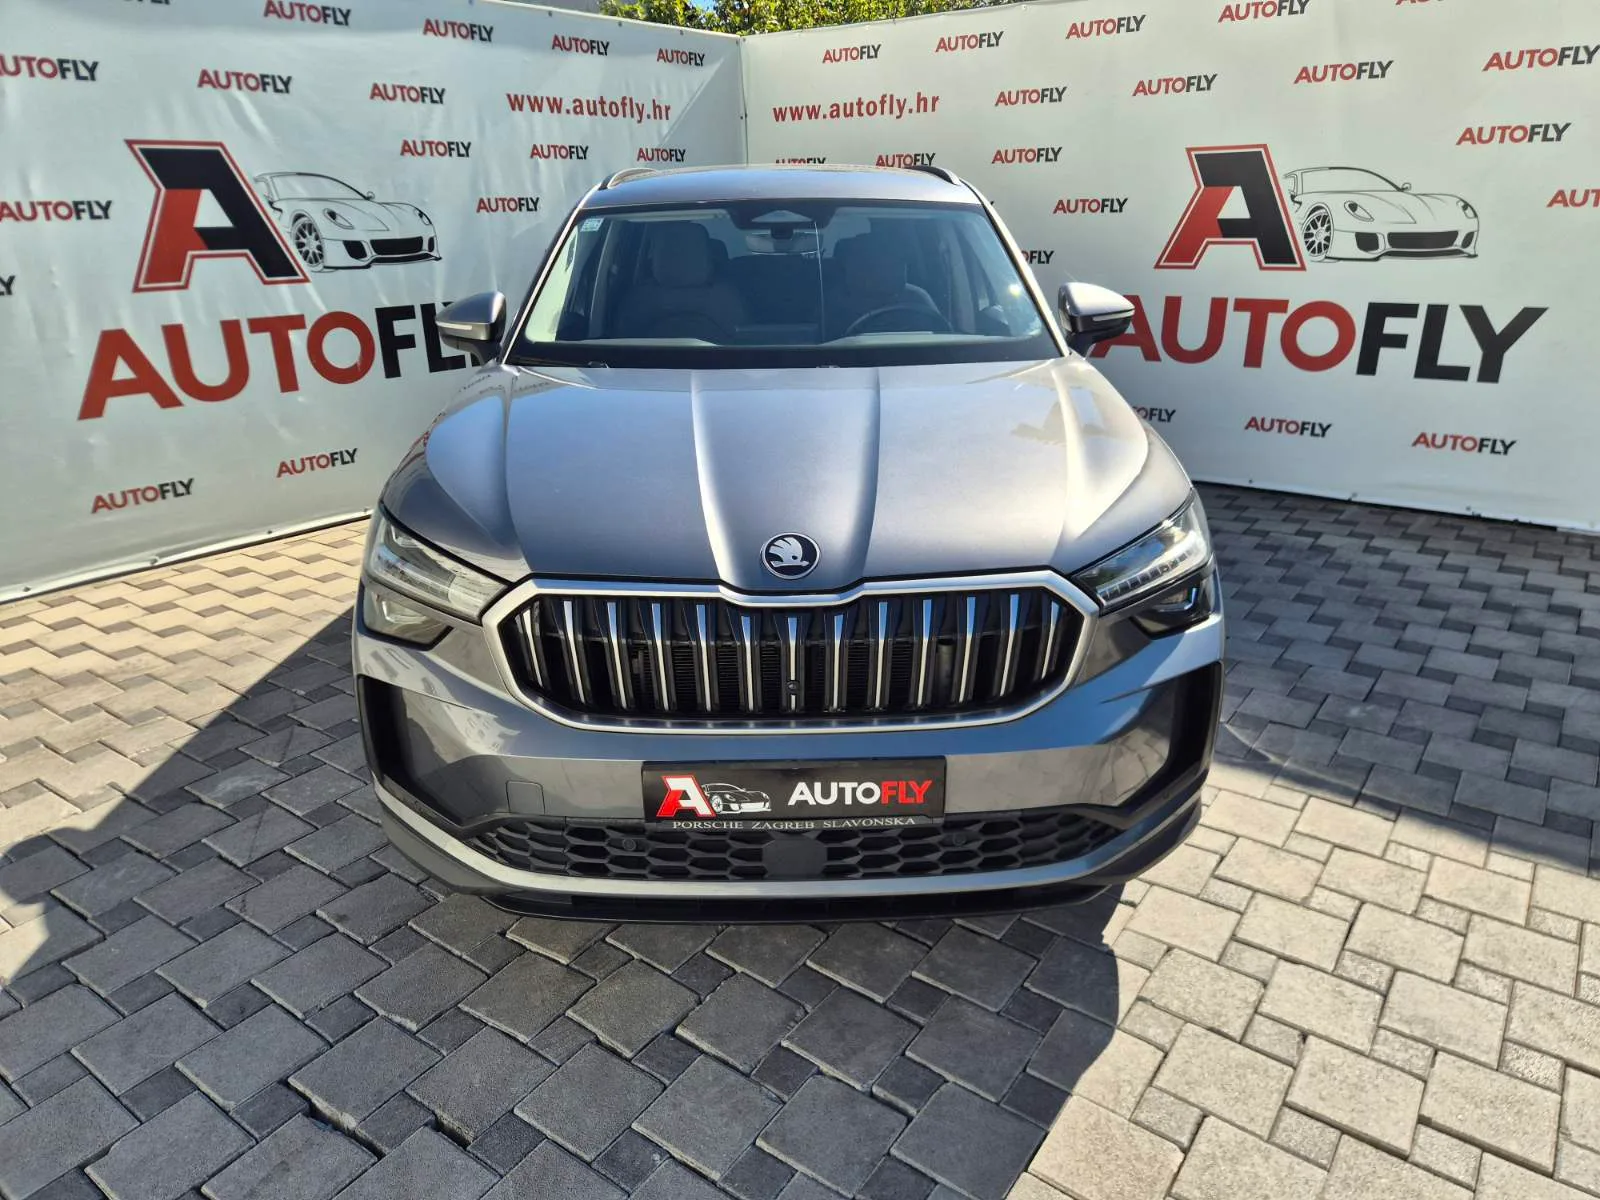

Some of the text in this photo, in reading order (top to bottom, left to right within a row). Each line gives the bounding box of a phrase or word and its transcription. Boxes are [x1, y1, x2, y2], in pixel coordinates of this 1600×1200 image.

[264, 0, 351, 26] AUTOFLY
[1218, 0, 1309, 23] AUTOFLY
[423, 19, 493, 42] AUTOFLY
[1066, 15, 1146, 39] AUTOFLY
[552, 34, 610, 56] AUTOFLY
[935, 31, 1004, 52] AUTOFLY
[657, 48, 705, 66] AUTOFLY
[822, 44, 881, 63] AUTOFLY
[1482, 45, 1600, 71] AUTOFLY
[0, 55, 99, 81] UTOFLY
[1294, 60, 1394, 84] AUTOFLY
[197, 69, 292, 94] AUTOFLY
[1132, 74, 1218, 96] AUTOFLY
[370, 83, 445, 104] AUTOFLY
[995, 87, 1067, 107] AUTOFLY
[506, 93, 671, 123] www.autofly.hr
[773, 92, 939, 122] www.autofly.hr
[1456, 123, 1571, 145] AUTOFLY
[400, 140, 471, 158] AUTOFLY
[530, 144, 589, 160] AUTOFLY
[637, 148, 686, 162] AUTOFLY
[875, 152, 936, 167] AUTOFLY
[992, 147, 1062, 164] AUTOFLY
[0, 200, 112, 222] AUTOFLY
[476, 197, 539, 213] AUTOFLY
[1053, 198, 1128, 214] AUTOFLY
[1089, 294, 1549, 384] AUTOFLY
[77, 301, 482, 420] AUTOFL
[1244, 417, 1332, 437] AUTOFLY
[1412, 432, 1516, 455] AUTOFLY
[277, 448, 357, 478] AUTOFLY
[92, 478, 194, 514] AUTOFLY
[787, 780, 932, 806] AUTOFLY
[672, 817, 916, 830] PORSCHE ZAGREB SLAVONSKA
